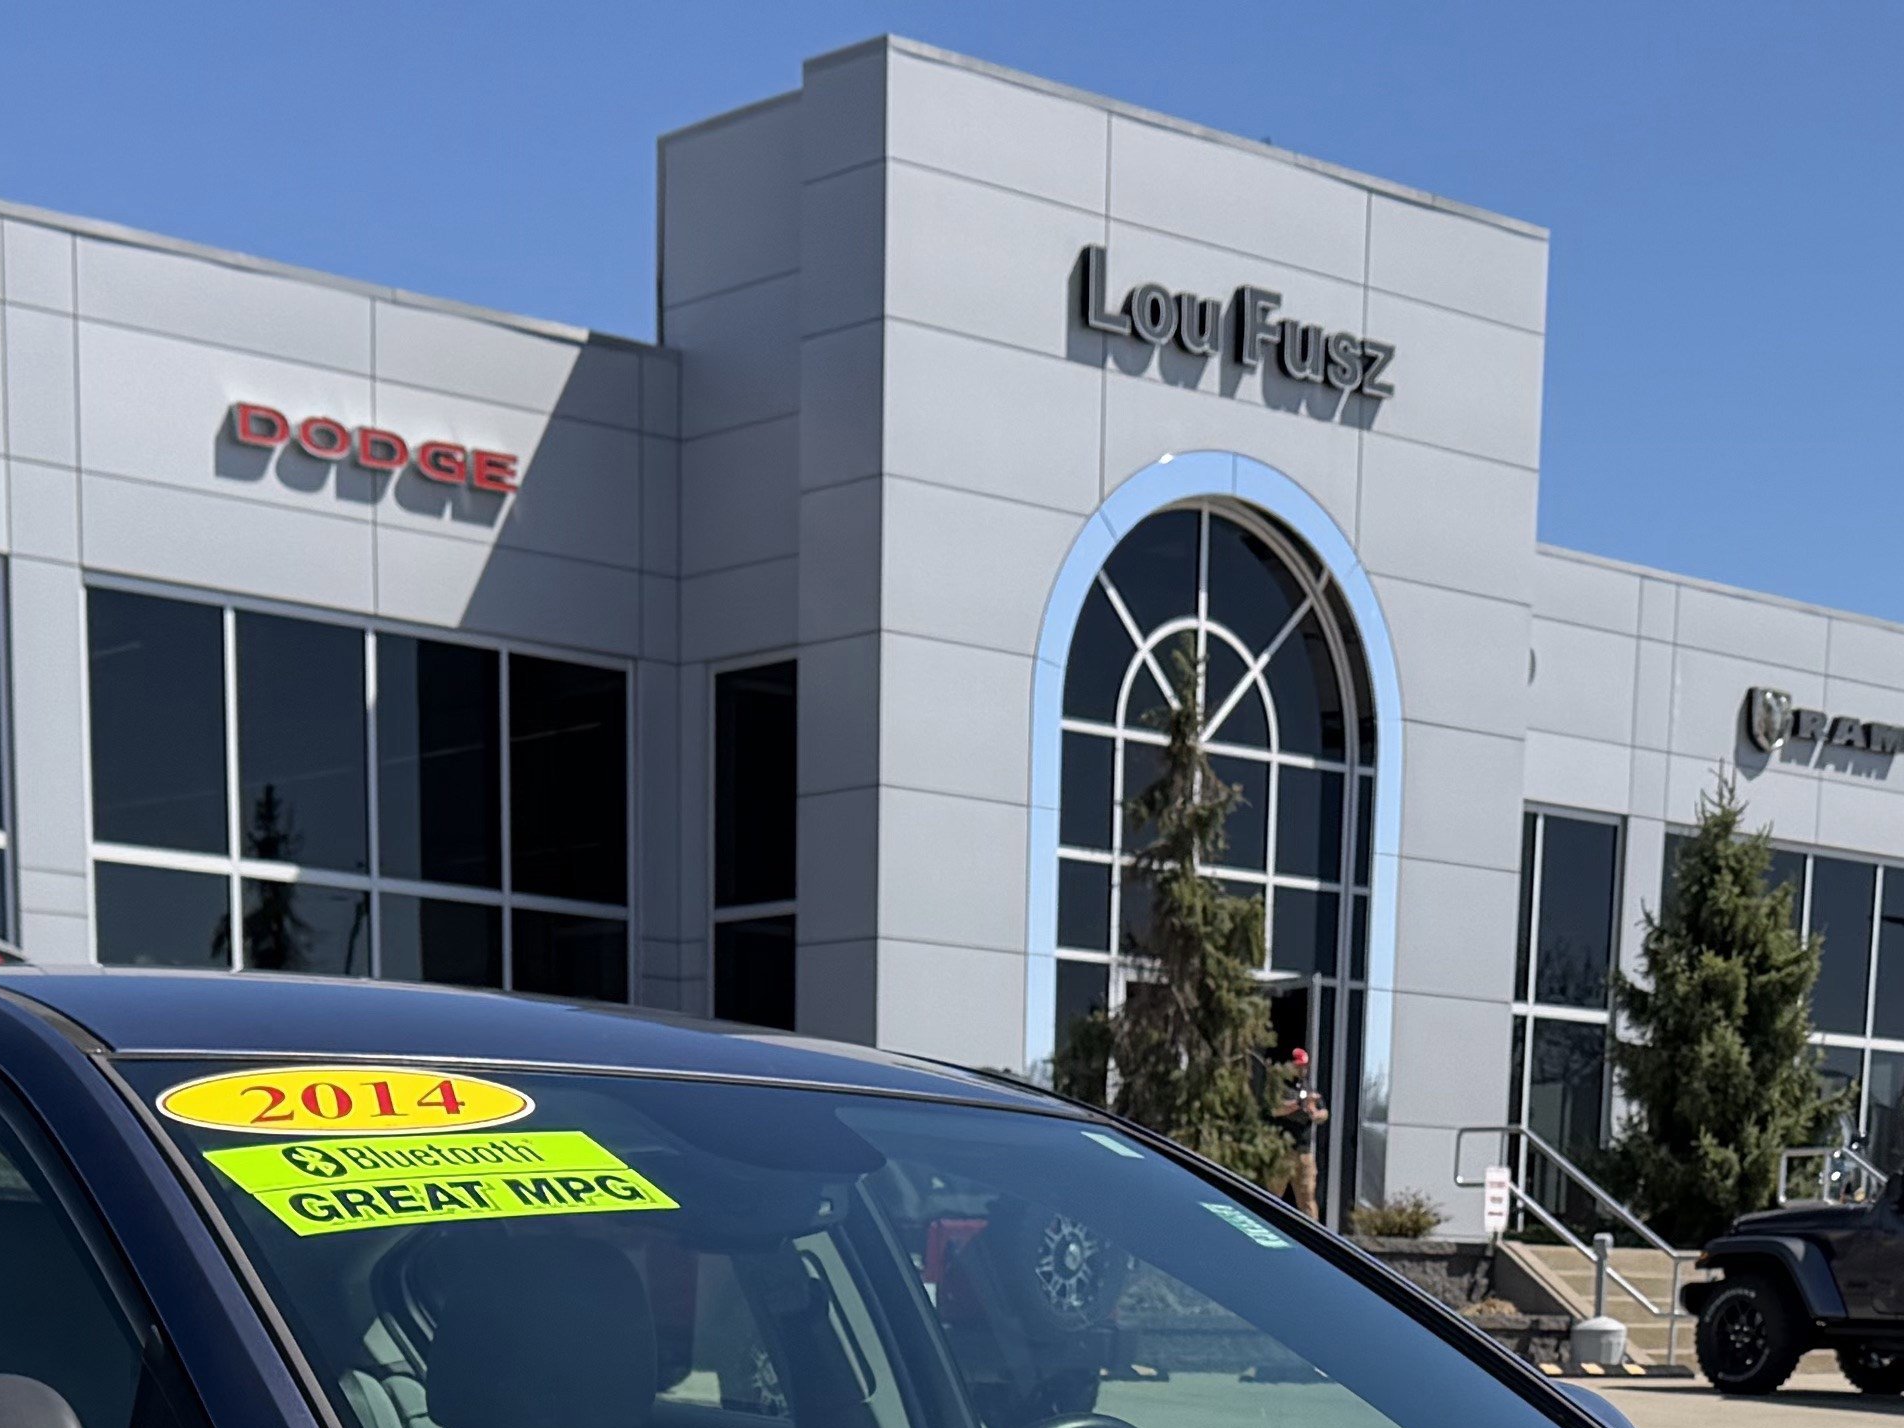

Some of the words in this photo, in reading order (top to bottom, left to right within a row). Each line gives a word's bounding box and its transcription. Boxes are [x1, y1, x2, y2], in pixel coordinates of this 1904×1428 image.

[1082, 245, 1222, 356] Lou
[1236, 286, 1396, 399] Fusz
[234, 400, 519, 494] DODGE
[239, 1078, 466, 1125] 2014
[337, 1138, 545, 1170] Bluetooth
[287, 1180, 493, 1223] GREAT
[501, 1174, 648, 1207] MPG
